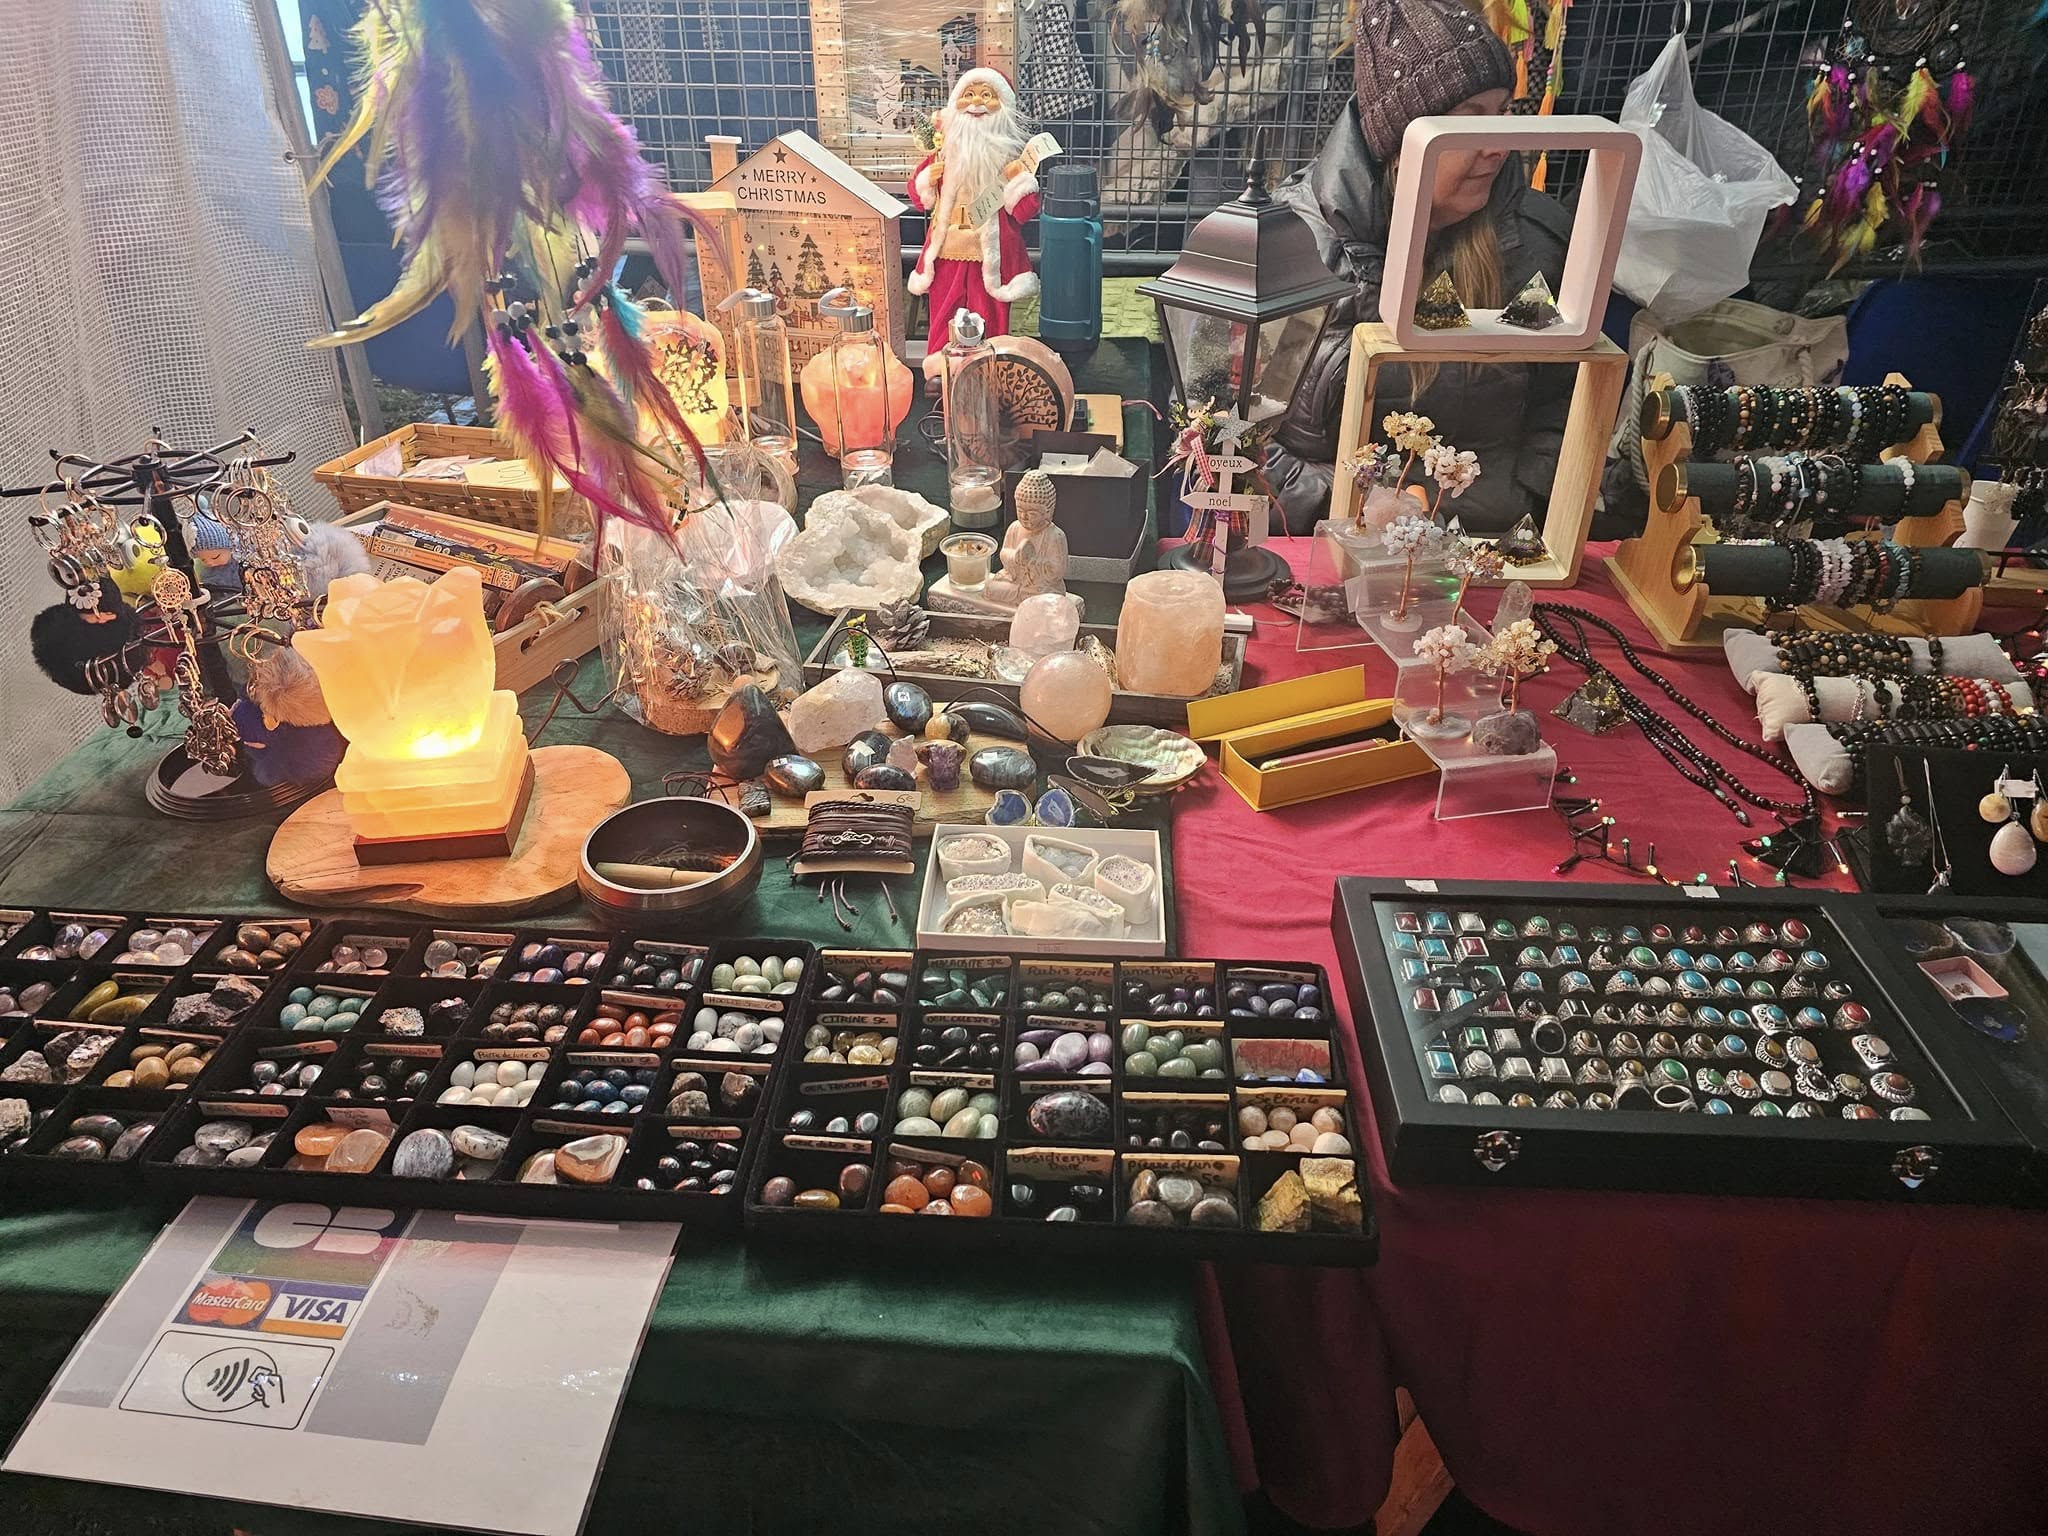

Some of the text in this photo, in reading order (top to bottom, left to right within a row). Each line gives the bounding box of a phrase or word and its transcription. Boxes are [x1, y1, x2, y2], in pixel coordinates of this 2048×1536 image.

[753, 169, 807, 185] MERRY
[737, 187, 827, 205] CHRISTMAS
[1209, 496, 1232, 507] noel
[192, 1291, 265, 1312] MasterCard
[286, 1296, 348, 1324] VISA
